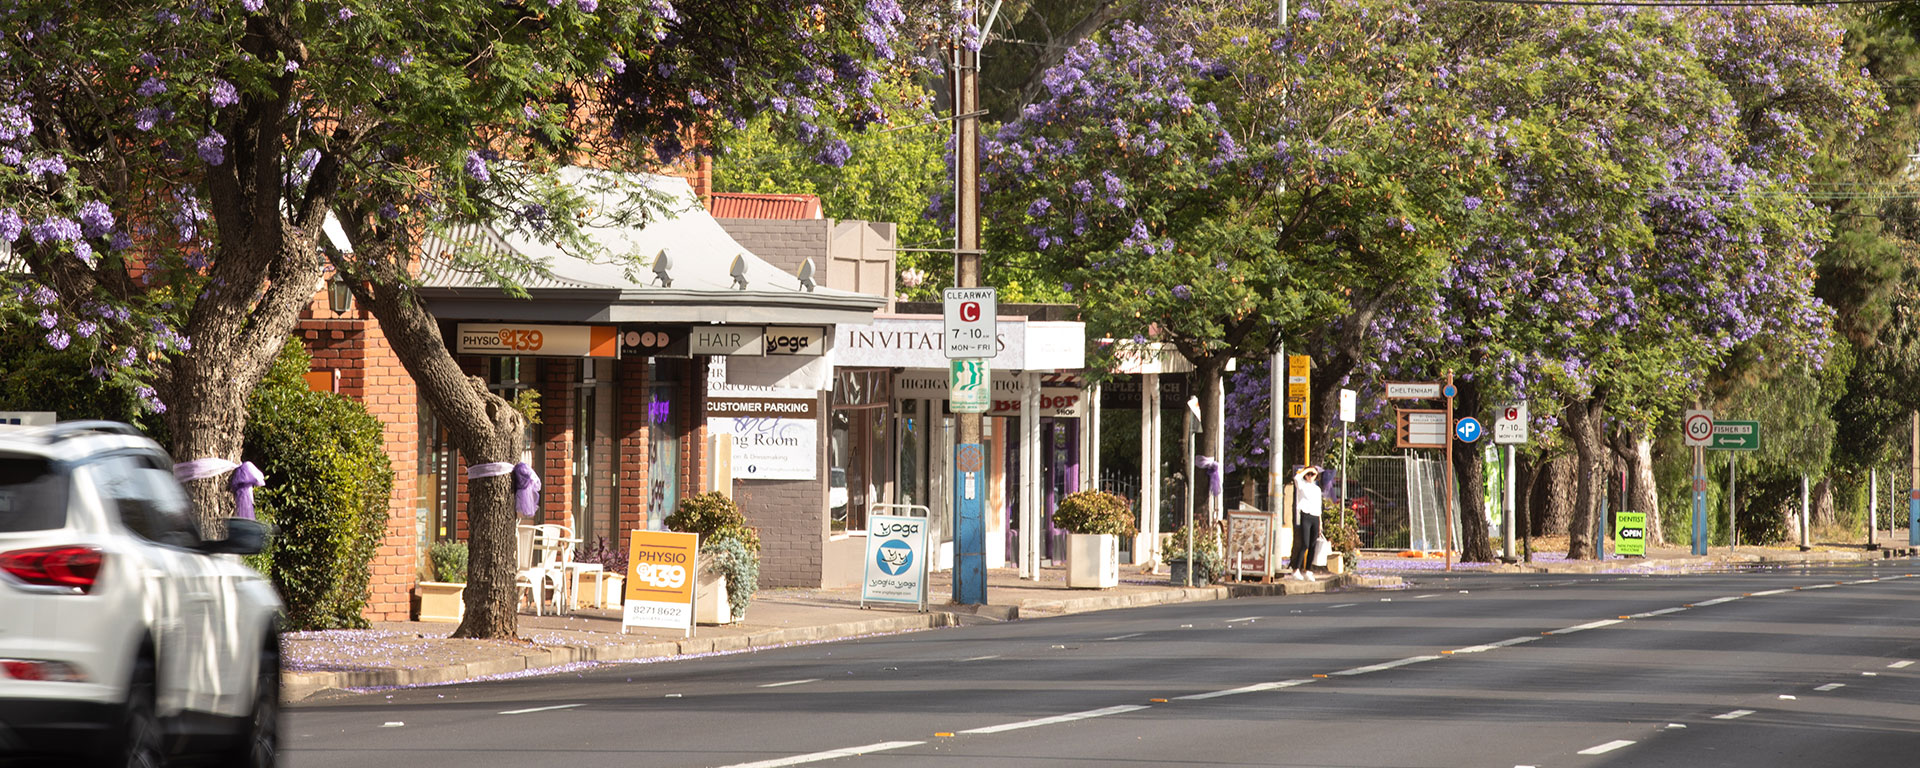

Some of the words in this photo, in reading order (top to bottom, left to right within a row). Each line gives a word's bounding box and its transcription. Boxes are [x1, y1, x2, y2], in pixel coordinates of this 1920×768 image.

[947, 291, 992, 300] CLEARWAY
[963, 302, 977, 321] C
[463, 336, 500, 346] PHYSIO
[499, 328, 544, 351] @439
[699, 332, 742, 347] HAIR
[952, 328, 960, 339] 7
[969, 328, 983, 339] 10
[766, 334, 809, 353] yoga
[848, 331, 1005, 352] INVITATS
[901, 379, 950, 390] HIGHGA
[1389, 386, 1433, 394] CHELTENHAM
[707, 402, 763, 413] CUSTOMER
[764, 403, 809, 413] PARKING
[994, 394, 1080, 412] Baber
[1056, 408, 1075, 416] SHOP
[1294, 404, 1302, 416] 10
[1507, 408, 1516, 420] C
[1465, 422, 1475, 438] P
[1691, 422, 1708, 434] 60
[754, 433, 799, 446] Room
[873, 522, 920, 538] yoga
[1622, 529, 1642, 538] OPEN
[638, 551, 687, 564] PHYSIO
[636, 562, 687, 588] @439
